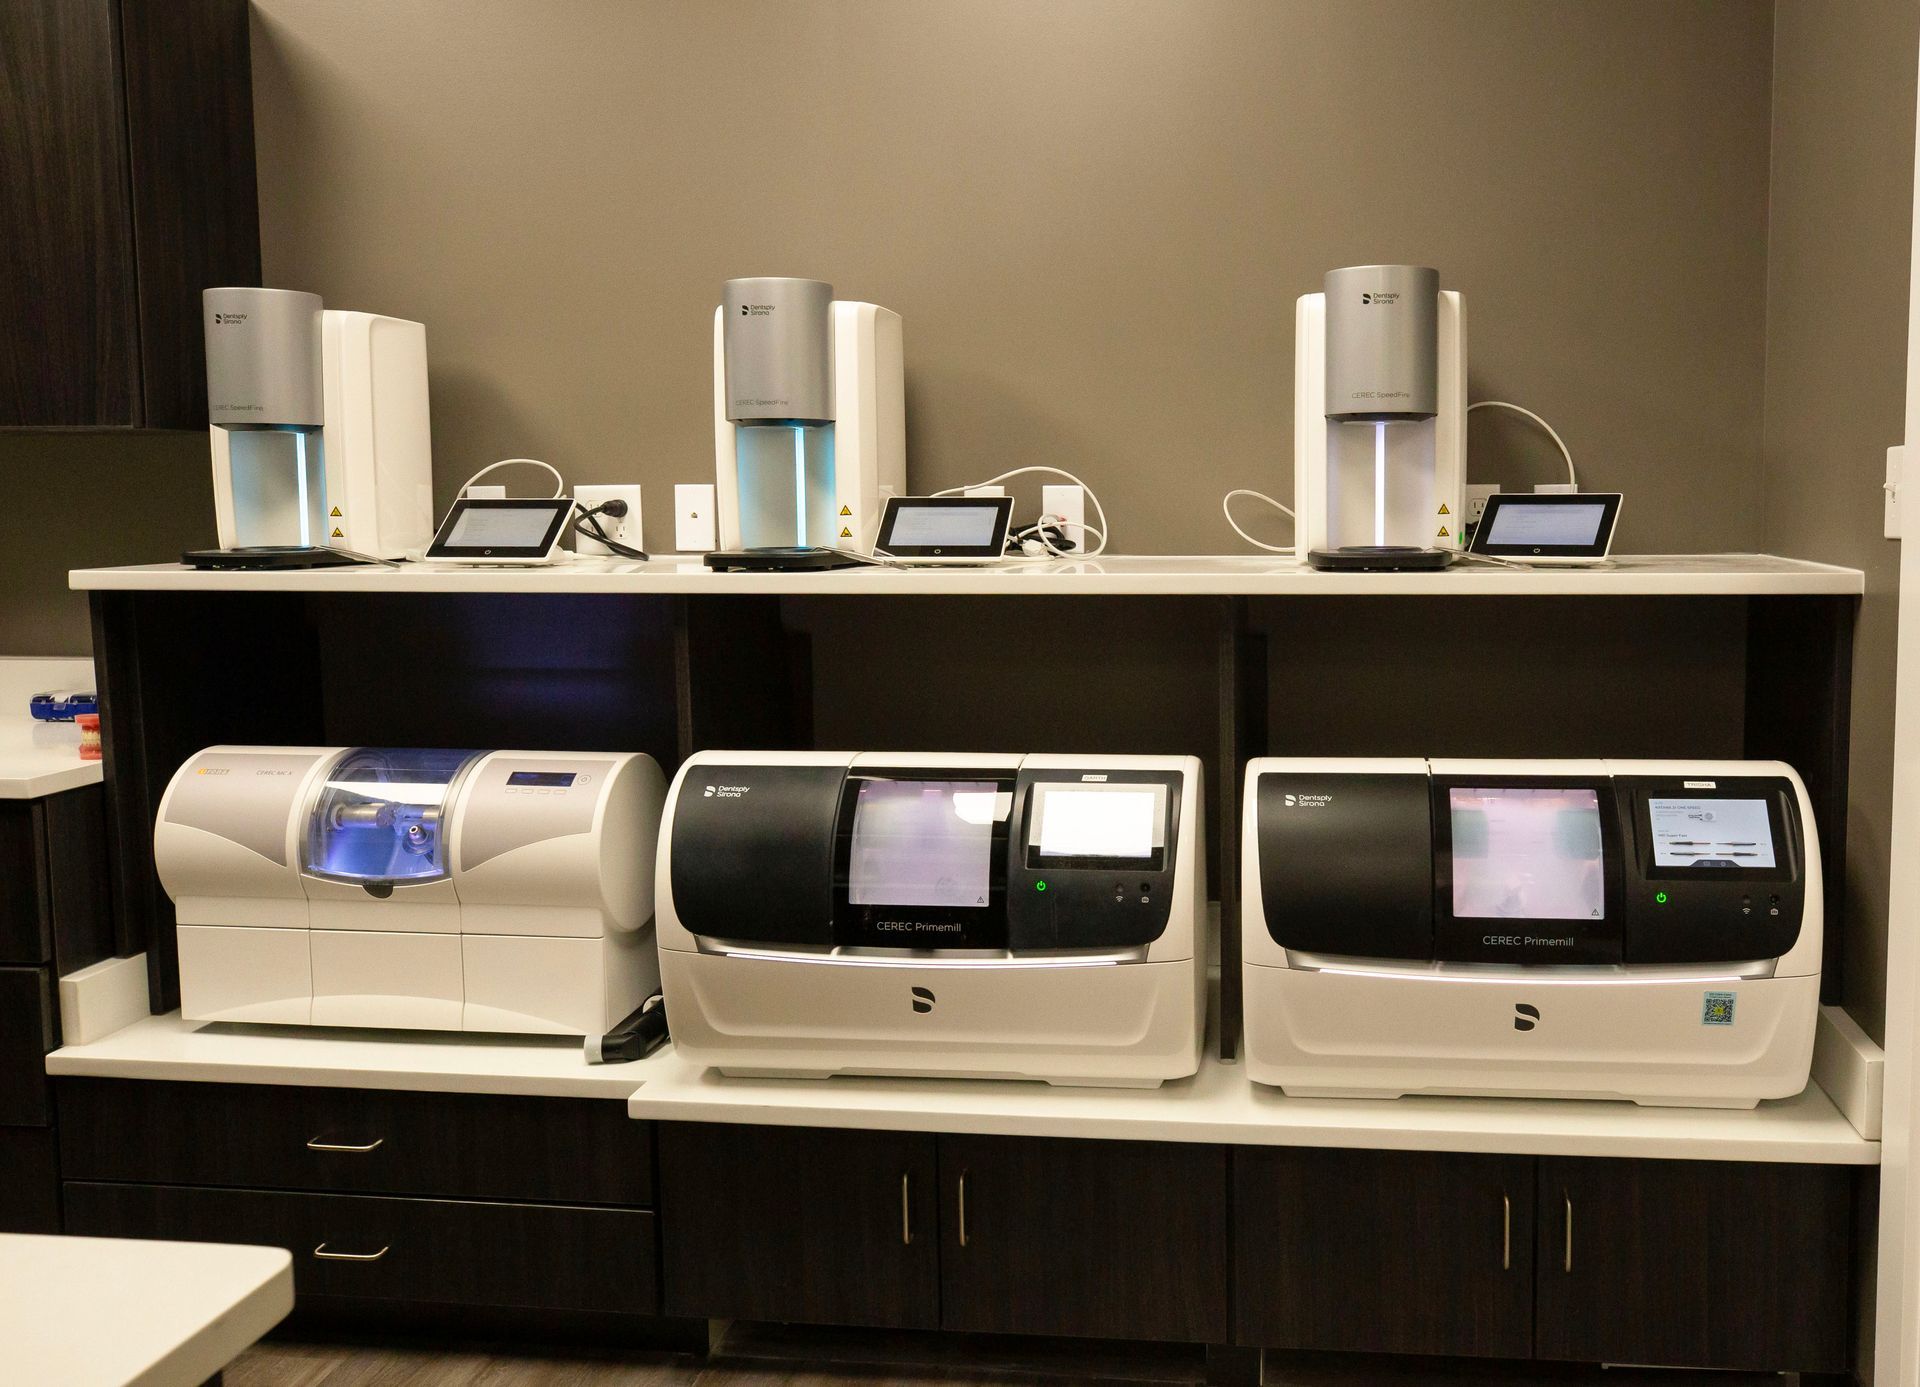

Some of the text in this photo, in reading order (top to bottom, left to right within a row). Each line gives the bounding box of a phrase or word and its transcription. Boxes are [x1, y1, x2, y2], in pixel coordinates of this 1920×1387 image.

[1373, 292, 1400, 300] Dentsply
[1351, 391, 1376, 399] CEREC
[718, 785, 751, 793] Dentsply
[1298, 794, 1333, 802] Dentsply
[876, 921, 962, 932] CEREC Primemill
[1482, 935, 1574, 947] CEREC Primemill
